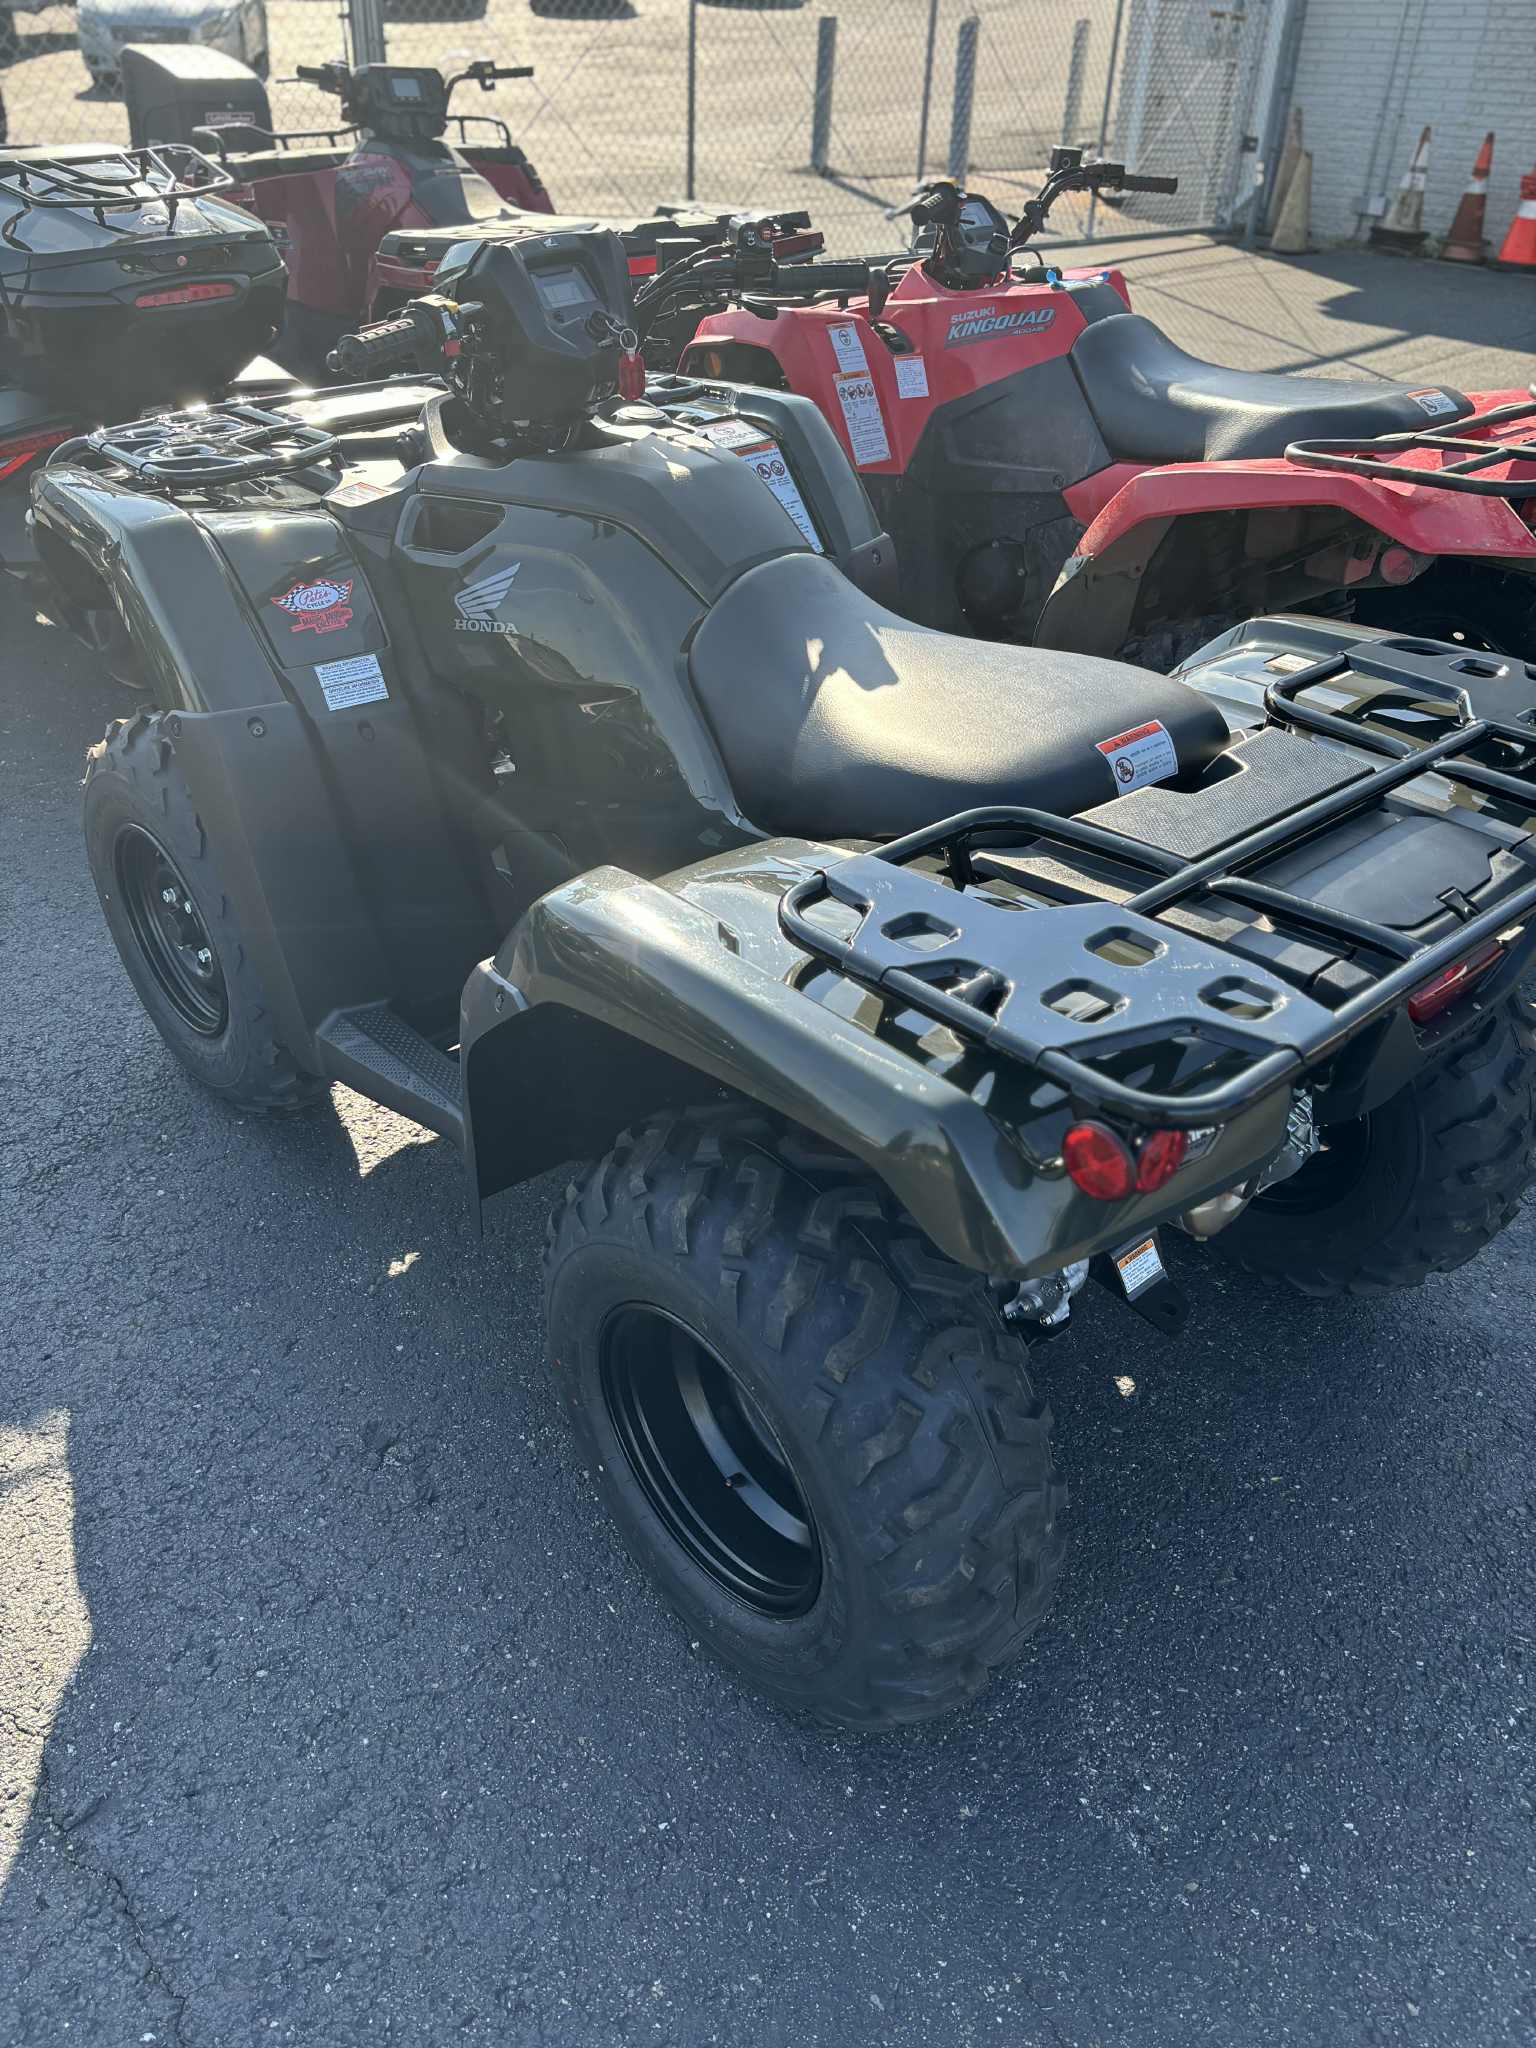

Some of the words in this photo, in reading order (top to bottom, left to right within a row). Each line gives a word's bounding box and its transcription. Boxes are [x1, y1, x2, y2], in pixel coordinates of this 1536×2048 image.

[951, 306, 996, 323] SUZUKI
[948, 309, 1056, 340] KINGQUAD
[454, 619, 520, 634] HONDA
